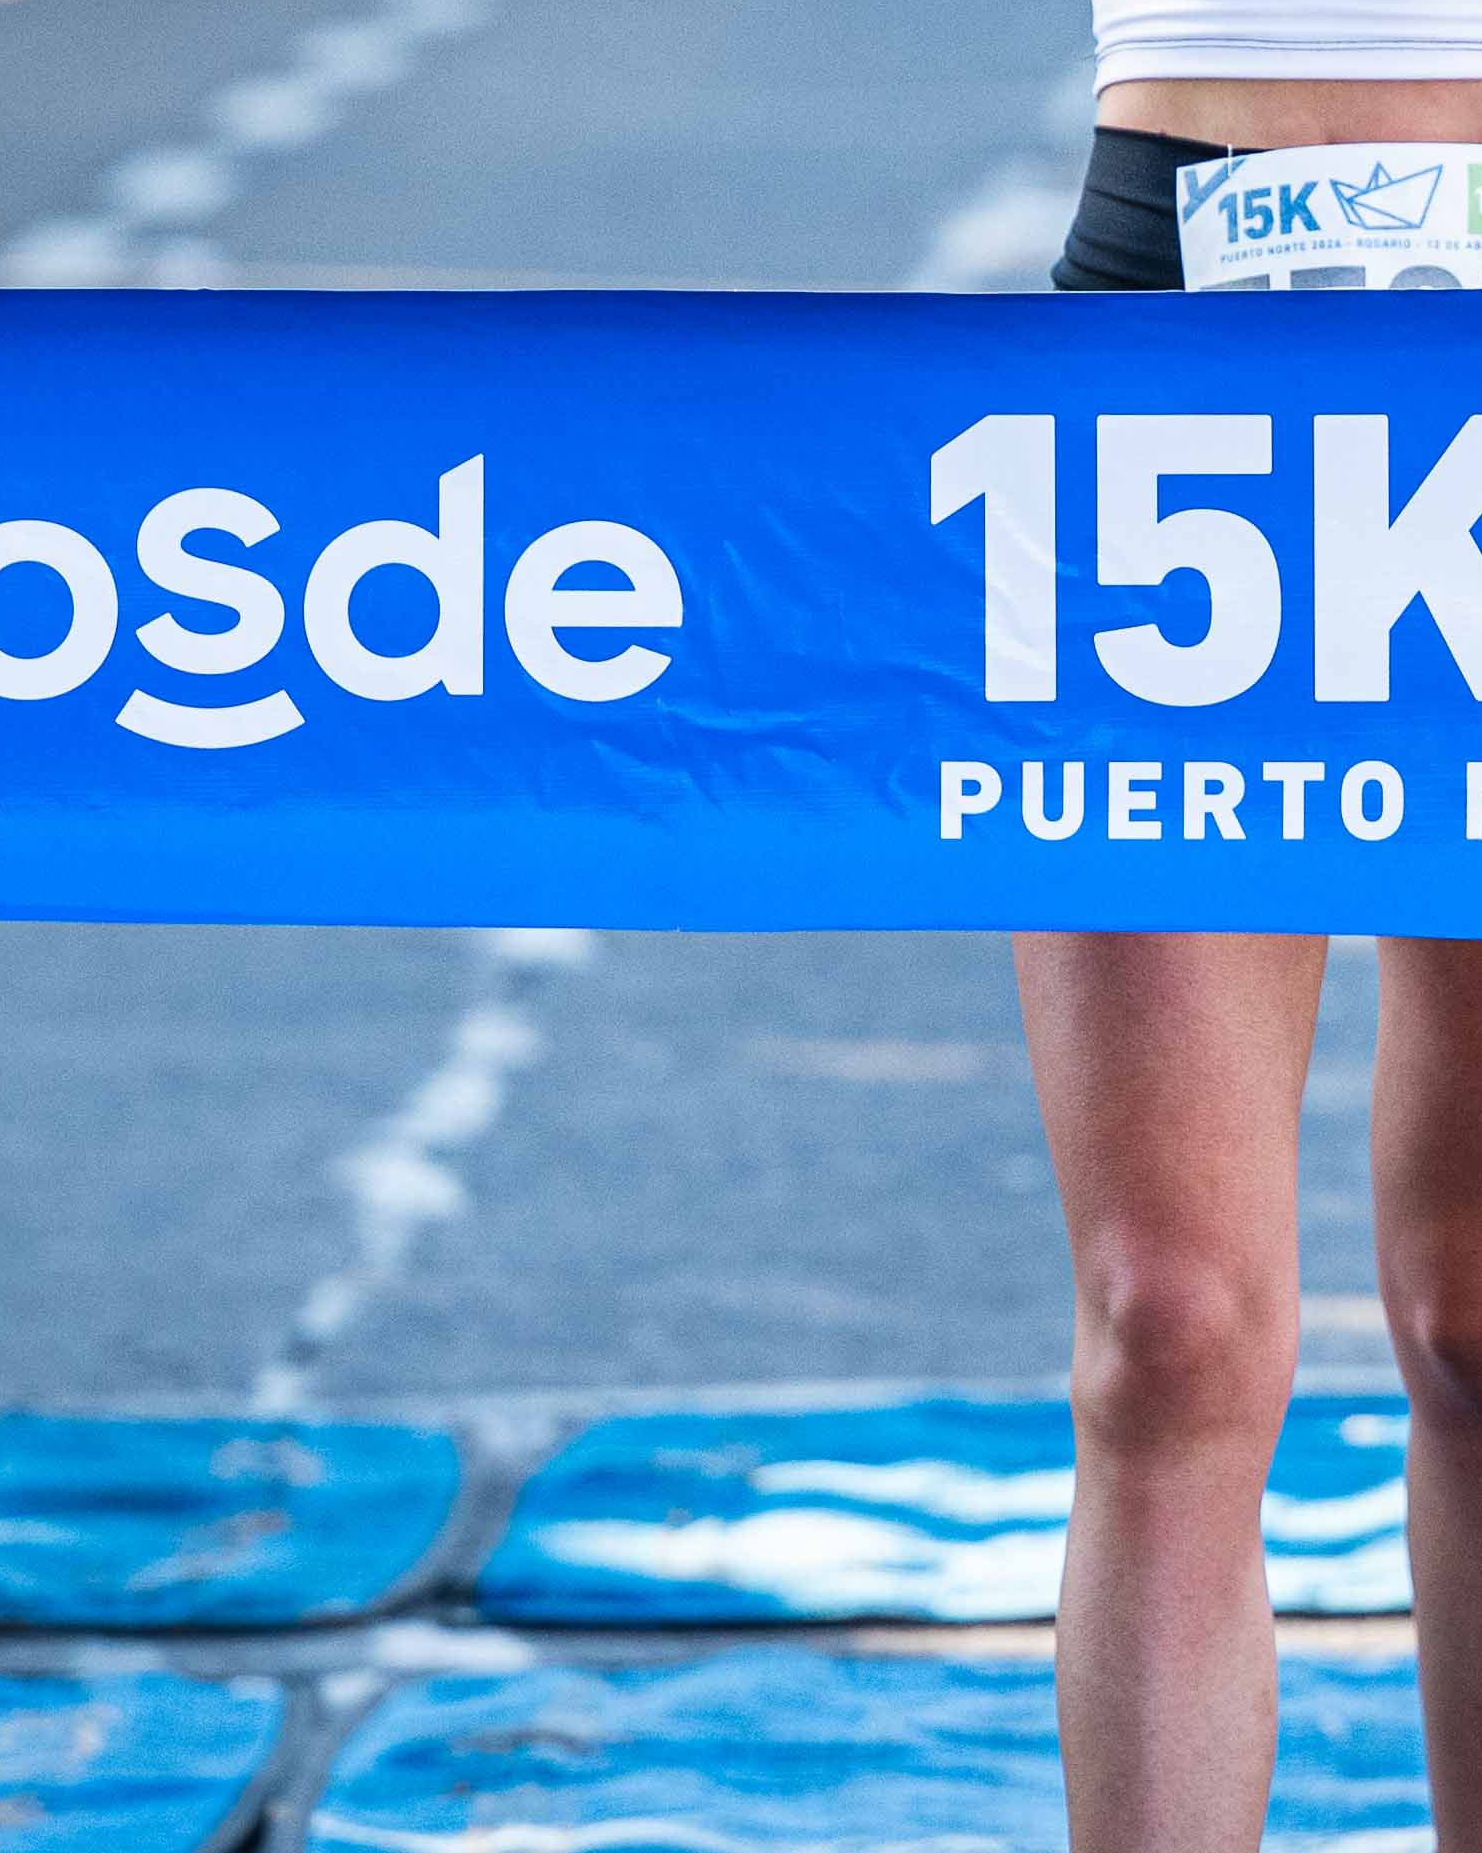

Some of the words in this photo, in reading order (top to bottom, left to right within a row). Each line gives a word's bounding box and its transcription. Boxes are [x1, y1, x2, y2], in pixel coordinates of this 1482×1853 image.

[1219, 181, 1321, 244] 15K
[1221, 247, 1264, 263] PUERTO
[1268, 241, 1307, 255] NORTE
[940, 760, 1404, 841] PUERTO
